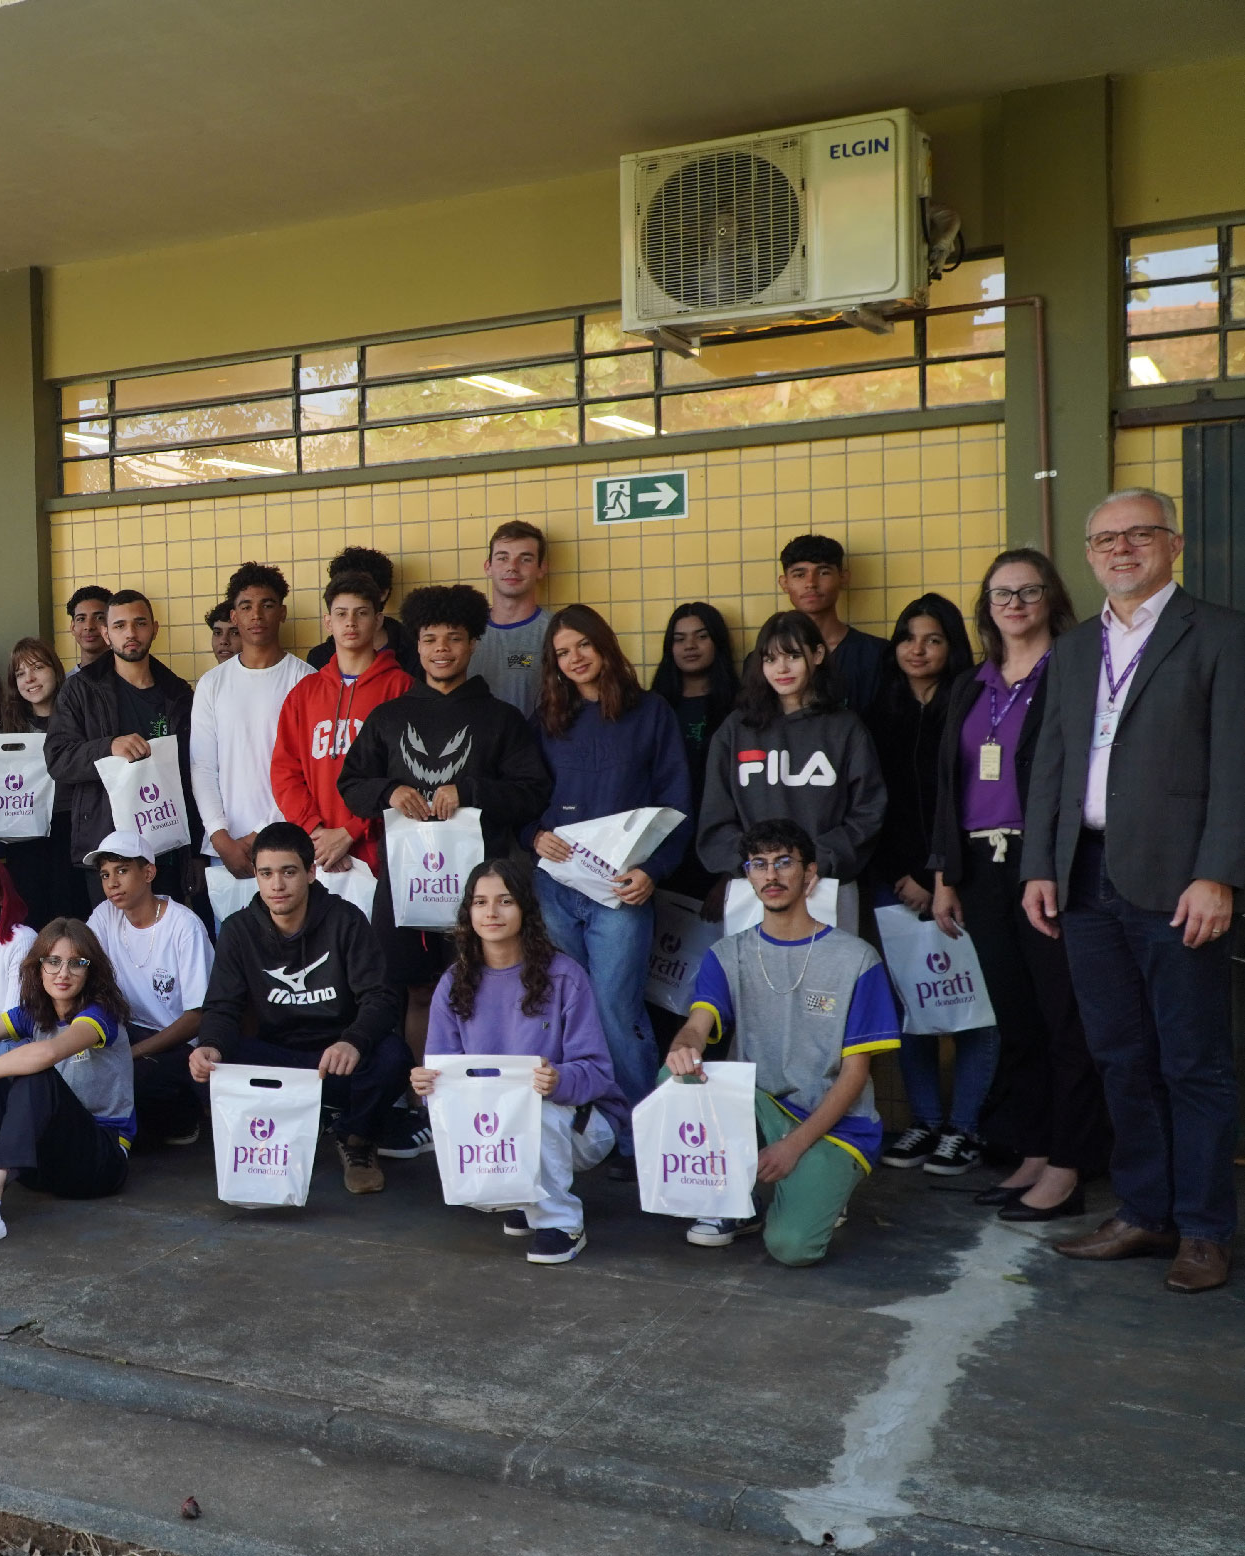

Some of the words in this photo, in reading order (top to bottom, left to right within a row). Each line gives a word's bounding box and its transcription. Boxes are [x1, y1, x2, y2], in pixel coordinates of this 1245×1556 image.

[829, 136, 890, 160] ELGIN
[311, 718, 364, 760] GA
[737, 749, 837, 787] FILA
[134, 798, 178, 835] prati
[409, 873, 460, 902] prati
[915, 970, 975, 1009] prati
[233, 1143, 289, 1173] prati
[247, 1166, 288, 1177] donaduzzi
[457, 1137, 517, 1174] prati
[475, 1164, 518, 1175] donaduzzi
[660, 1149, 727, 1183] prati
[679, 1175, 728, 1187] donaduzzi
